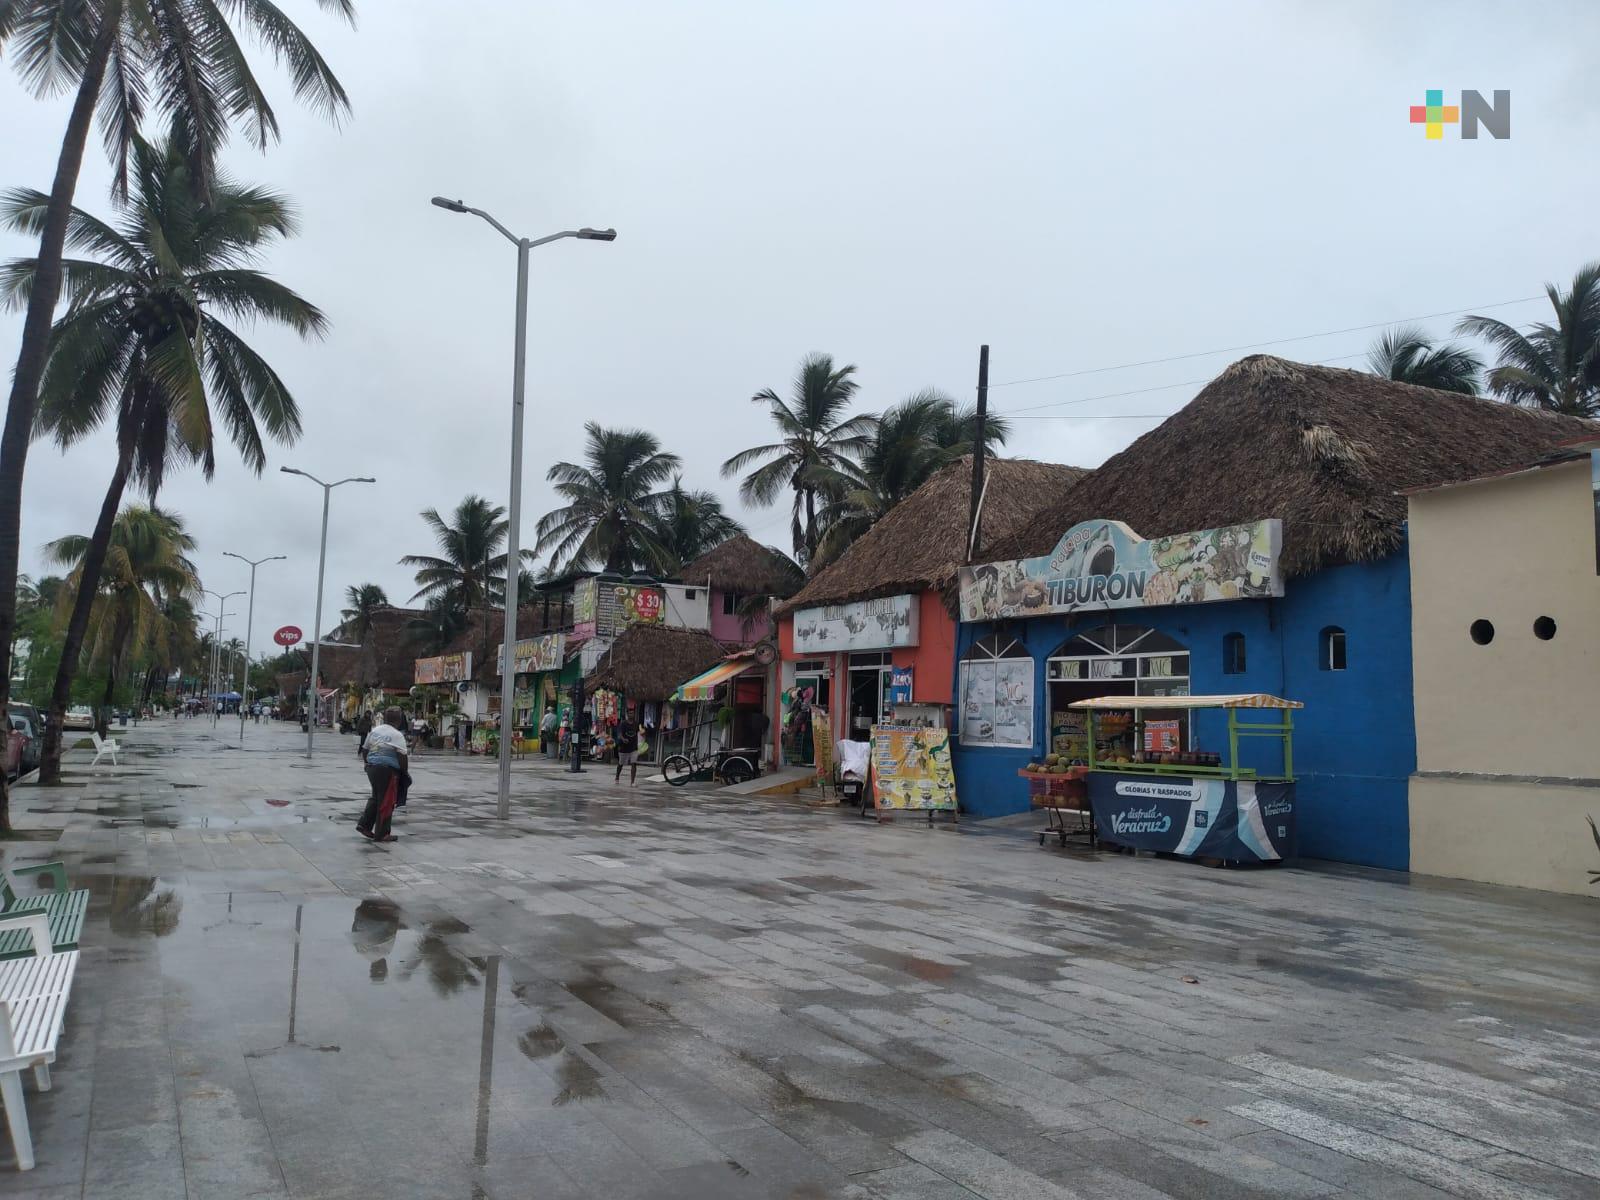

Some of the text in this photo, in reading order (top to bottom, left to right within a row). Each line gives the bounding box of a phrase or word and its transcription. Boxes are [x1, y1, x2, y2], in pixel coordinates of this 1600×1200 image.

[1046, 565, 1146, 606] TIBURÓN
[280, 631, 299, 641] vips
[1061, 661, 1079, 679] WC
[1092, 661, 1111, 679] WC
[1149, 657, 1172, 677] WC
[1157, 788, 1192, 798] RASPADOS
[1111, 811, 1172, 835] Veracruz
